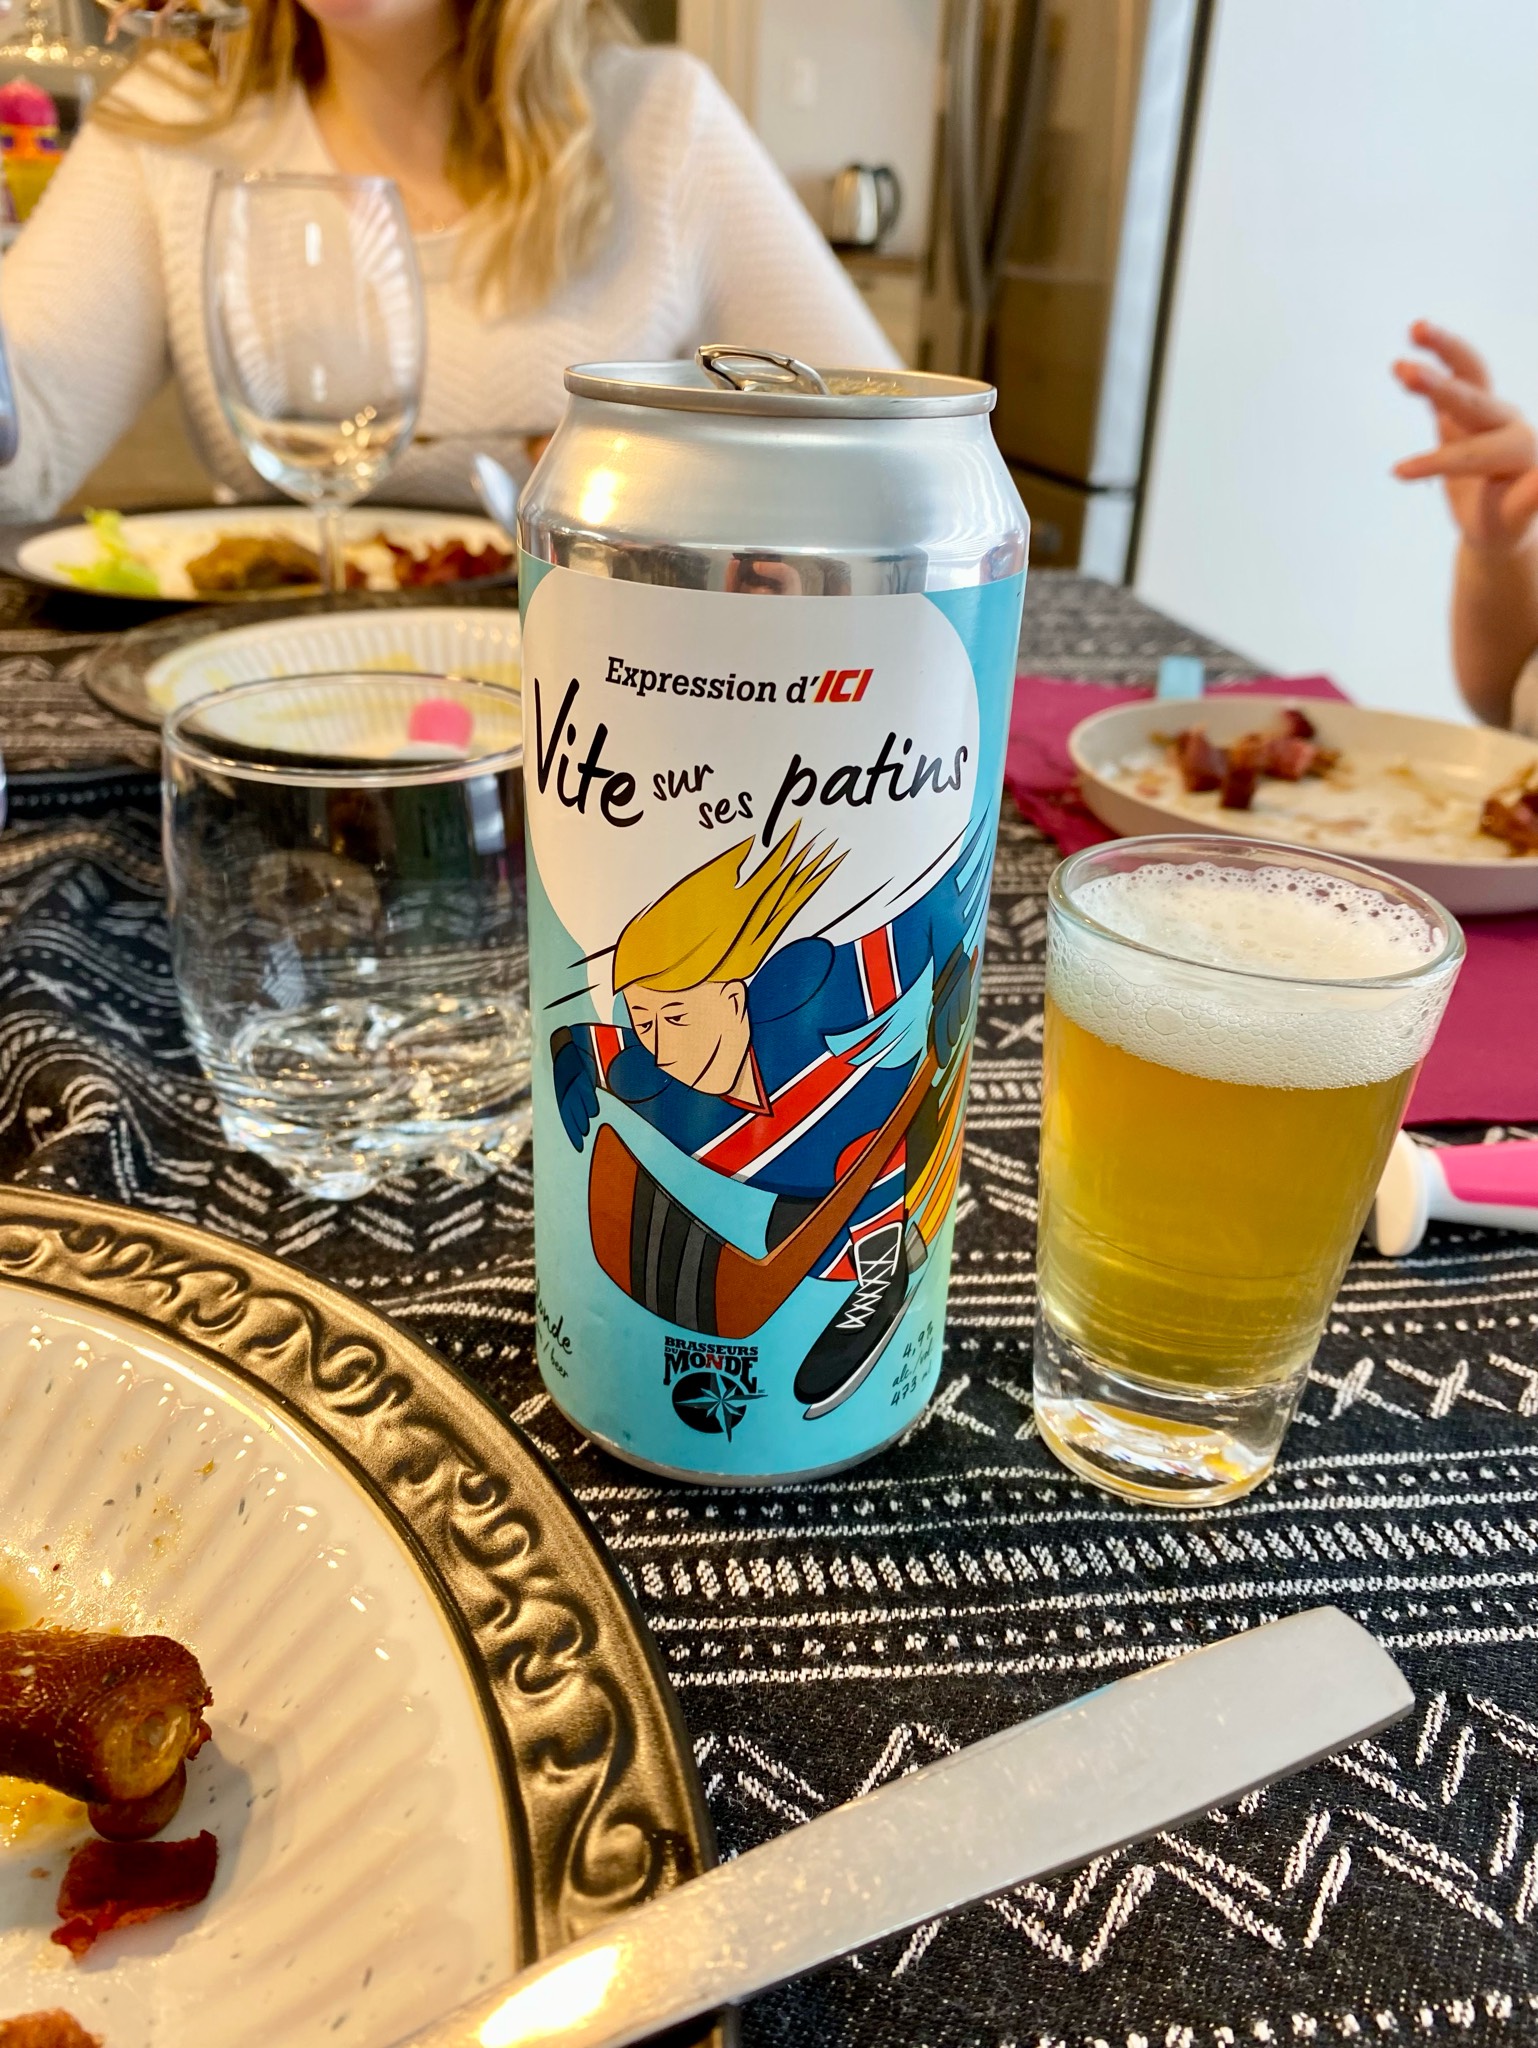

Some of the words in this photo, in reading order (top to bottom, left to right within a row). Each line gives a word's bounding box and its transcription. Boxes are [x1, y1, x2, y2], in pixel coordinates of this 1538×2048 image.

[605, 656, 778, 704] Expression
[533, 677, 645, 829] Vite
[652, 762, 715, 803] sur
[761, 731, 968, 849] patins
[698, 790, 754, 830] ses
[664, 1335, 759, 1356] BRASSEURS
[664, 1346, 679, 1355] DU
[663, 1349, 759, 1394] MONDE
[890, 1375, 918, 1407] 473
